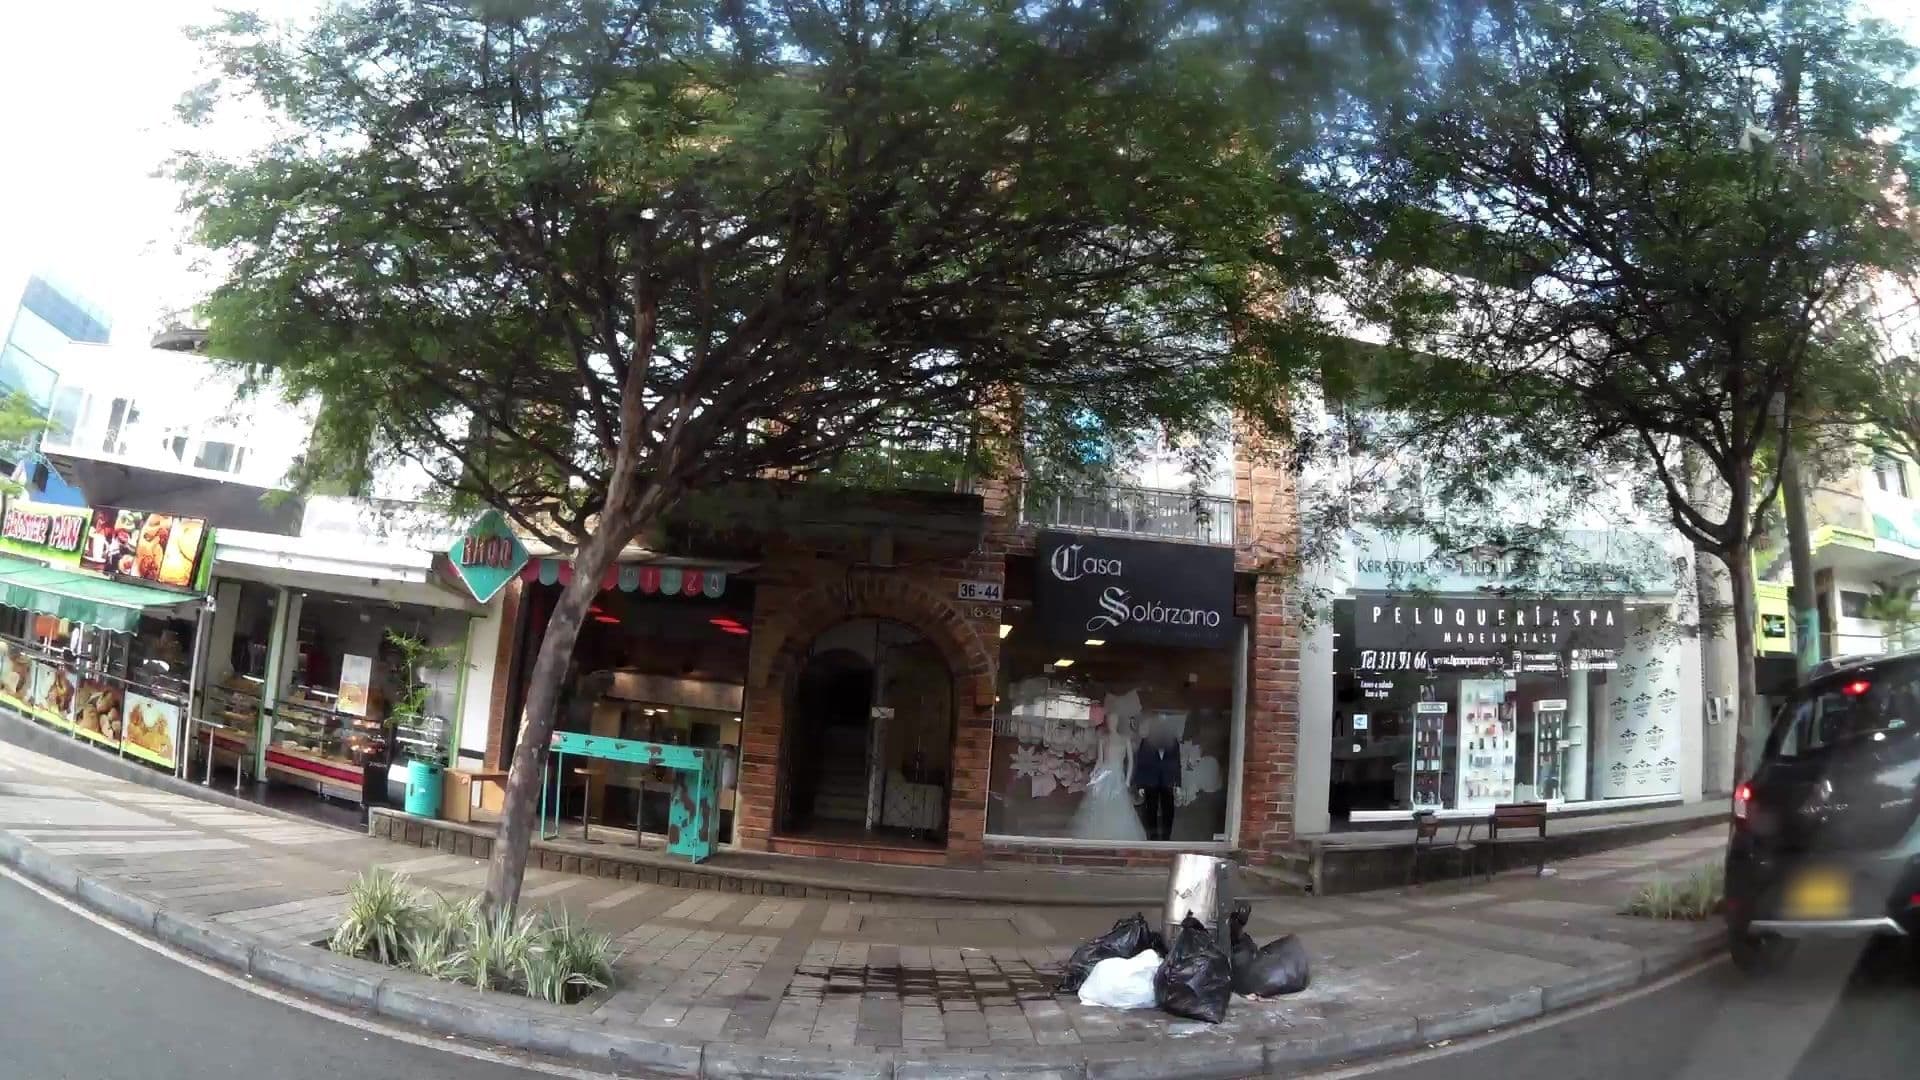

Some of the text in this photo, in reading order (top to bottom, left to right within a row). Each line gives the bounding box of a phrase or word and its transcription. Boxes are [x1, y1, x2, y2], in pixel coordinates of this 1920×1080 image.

[1051, 544, 1122, 581] Casa
[1087, 586, 1220, 631] Solórzano
[1373, 605, 1615, 626] PELUQUERÍA SPA
[1444, 632, 1485, 644] MADE
[1492, 632, 1507, 643] IN
[1361, 650, 1428, 670] Tel 311 91 66
